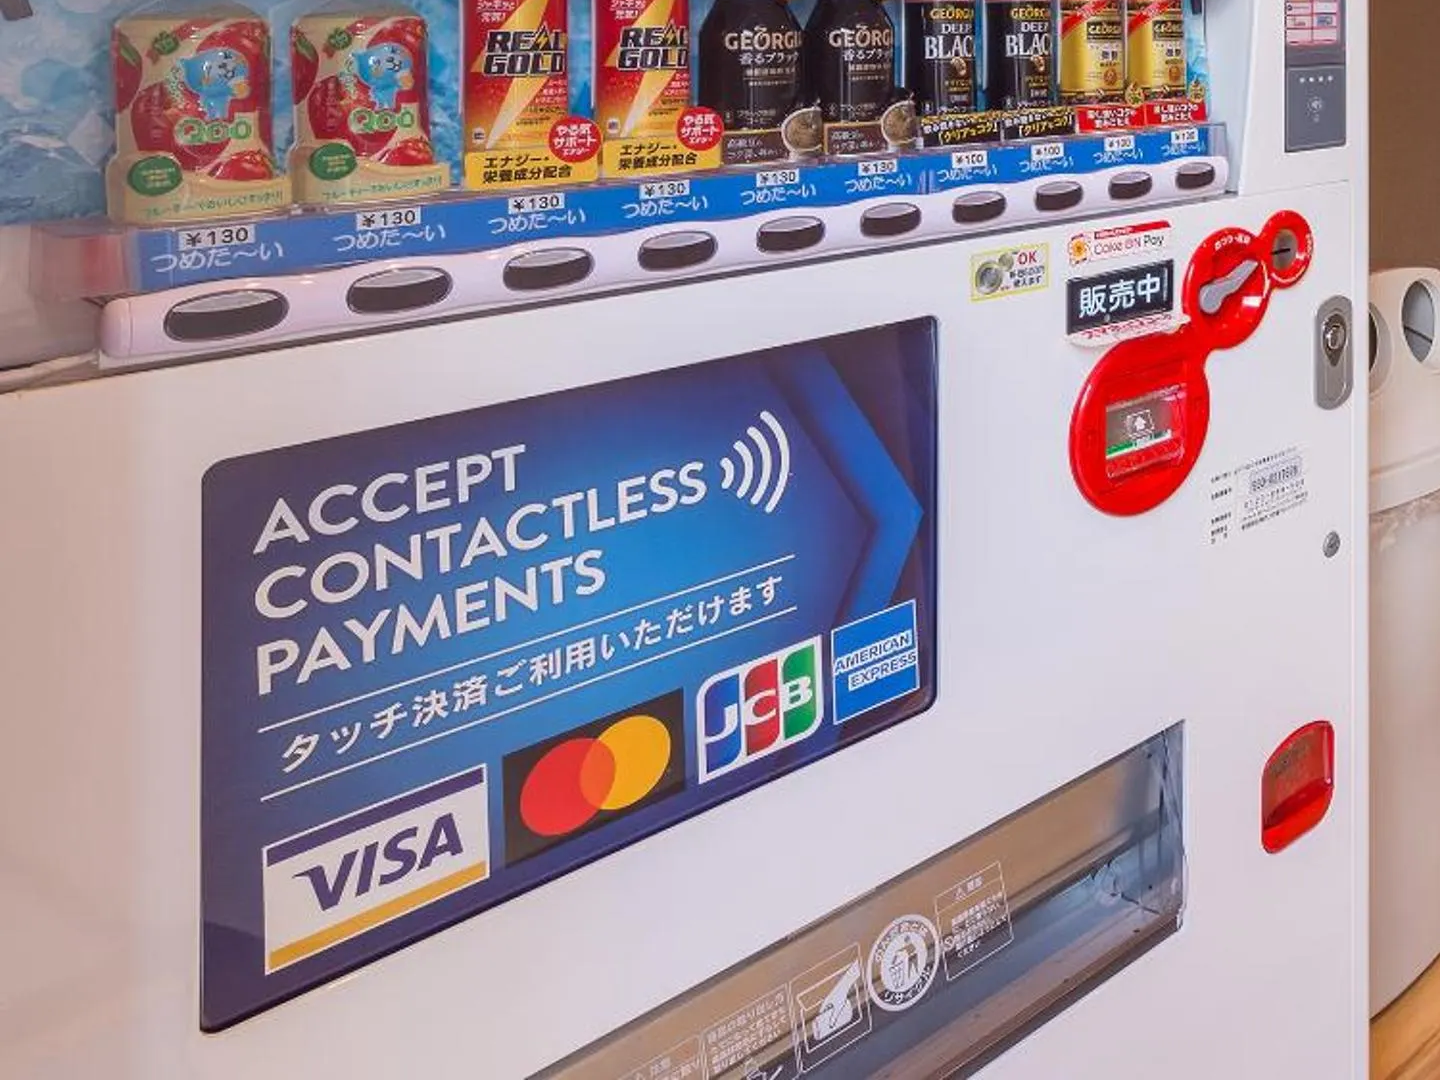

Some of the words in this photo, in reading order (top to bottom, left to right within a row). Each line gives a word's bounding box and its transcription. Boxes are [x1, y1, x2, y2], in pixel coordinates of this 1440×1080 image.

[486, 22, 568, 53] REAL
[619, 19, 690, 50] REAL
[924, 34, 976, 61] BLAC
[1004, 33, 1051, 58] BLAC
[482, 51, 567, 77] GOLD
[617, 47, 690, 72] GOLD
[482, 164, 573, 184] 栄養成分配合
[617, 152, 699, 170] 栄養成分配合
[643, 182, 686, 197] ¥130
[760, 172, 796, 185] ¥130
[512, 195, 560, 212] ¥130
[361, 210, 416, 228] ¥130
[185, 228, 249, 247] ¥130
[1093, 239, 1124, 256] Coke
[1143, 234, 1165, 248] Pay
[1017, 251, 1038, 266] OK
[1078, 272, 1161, 320] 販売中
[253, 443, 526, 555] ACCEPT
[253, 459, 707, 620] CONTACTLESS
[256, 549, 608, 697] PAYMENTS
[835, 633, 911, 673] AMERICAN
[280, 574, 784, 775] タッチ決済ご利用いただけます
[850, 651, 917, 688] EXPRESS
[292, 811, 464, 913] VISA
